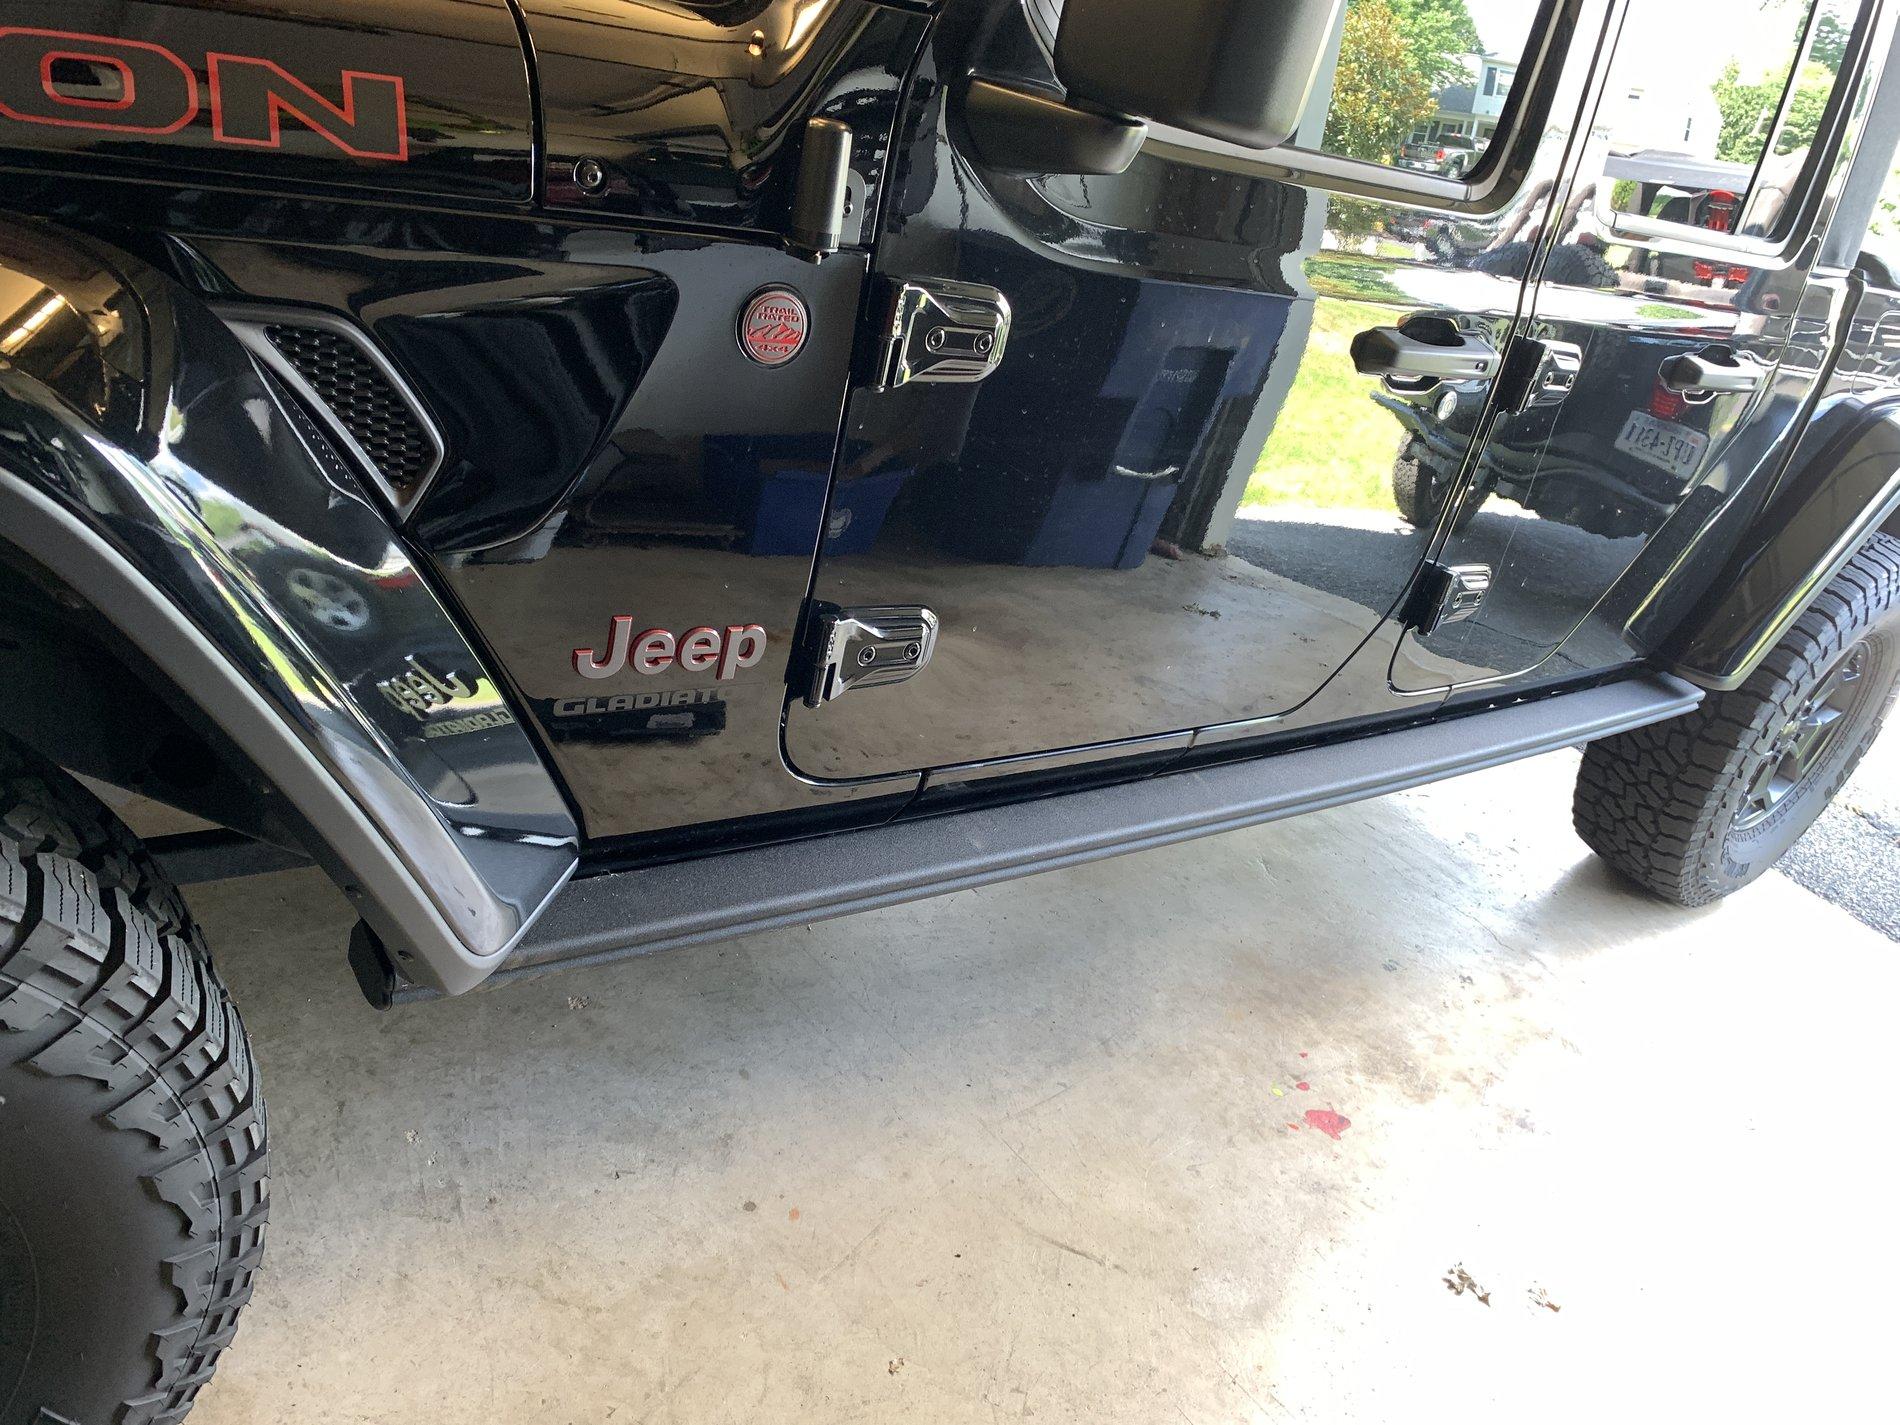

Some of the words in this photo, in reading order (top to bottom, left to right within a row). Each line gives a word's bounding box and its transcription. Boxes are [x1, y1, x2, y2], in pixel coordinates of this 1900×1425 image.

[0, 27, 408, 161] ON
[757, 313, 800, 323] RATED
[760, 306, 798, 316] TRAIL
[571, 614, 767, 680] Jeep
[553, 687, 728, 718] GLADIAT
